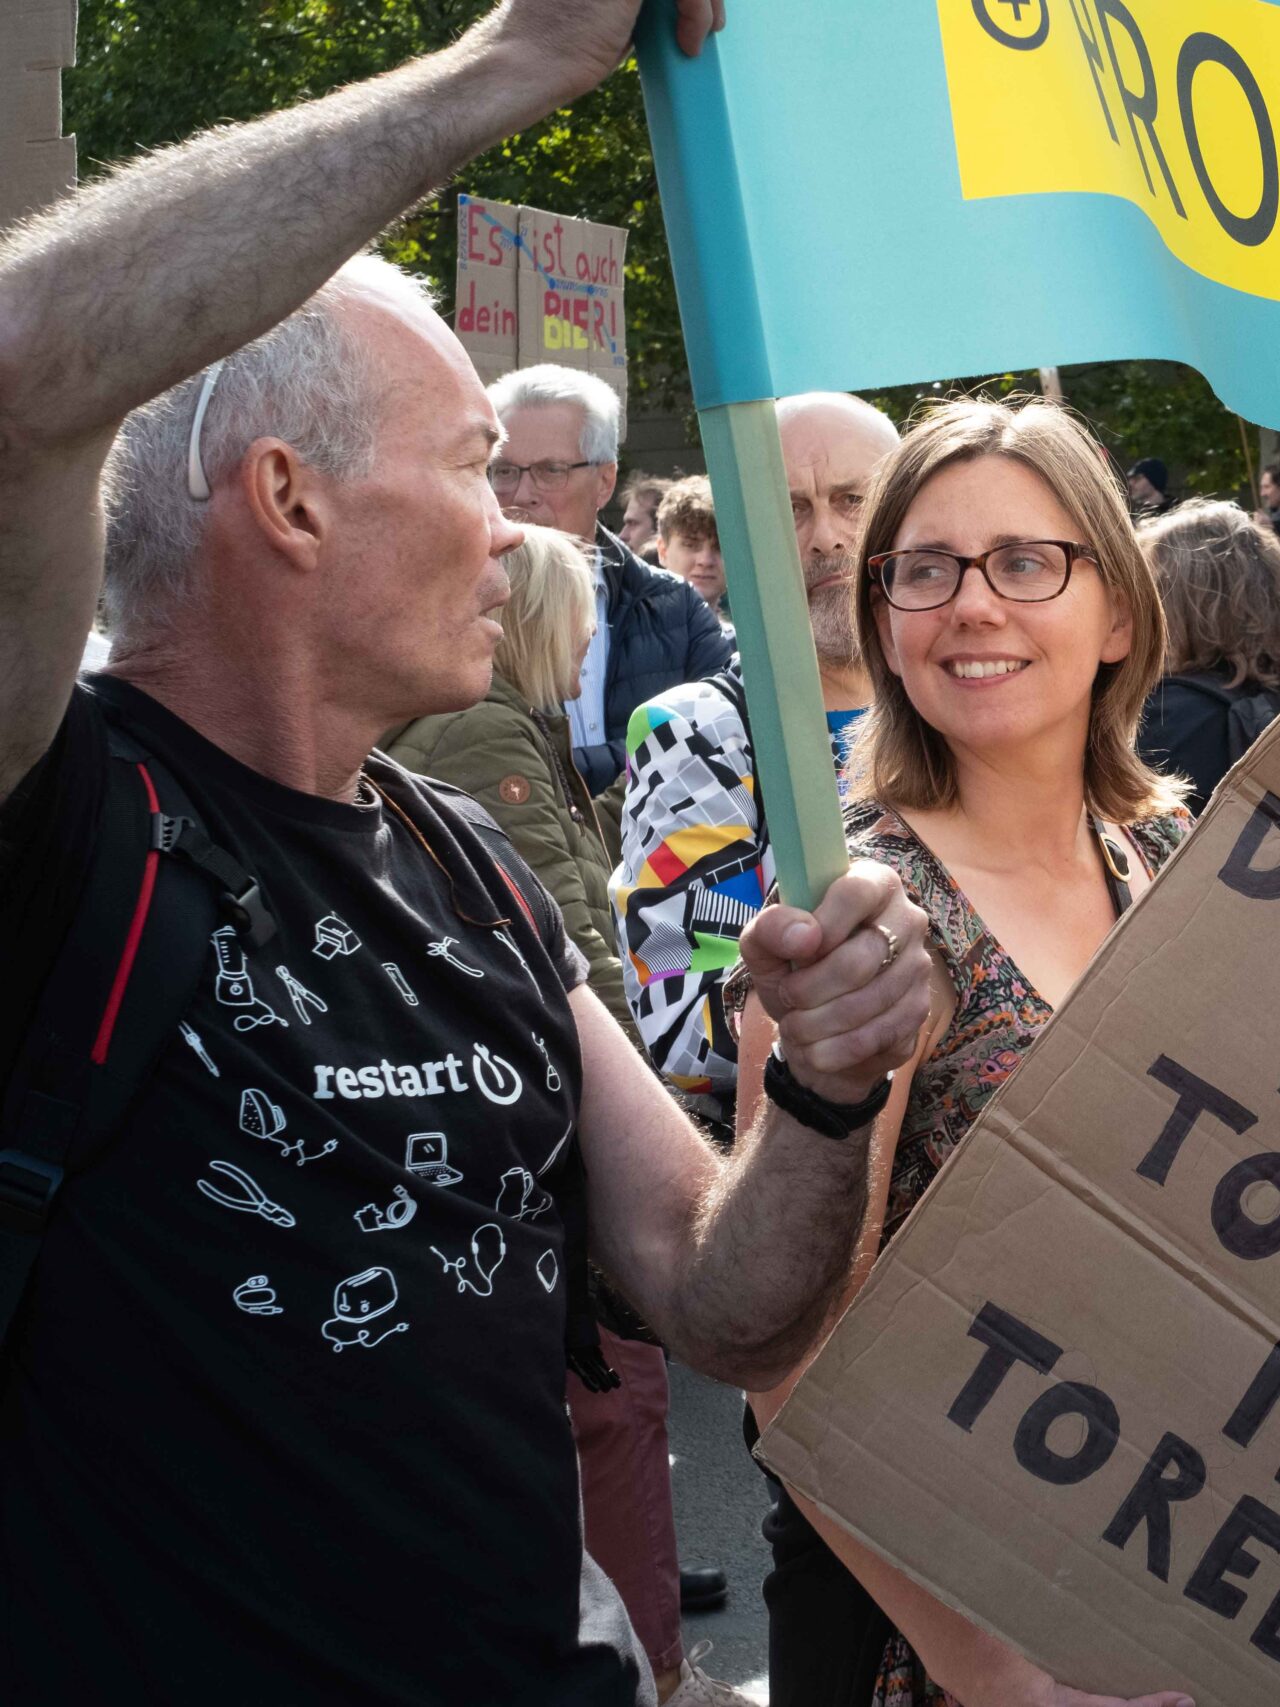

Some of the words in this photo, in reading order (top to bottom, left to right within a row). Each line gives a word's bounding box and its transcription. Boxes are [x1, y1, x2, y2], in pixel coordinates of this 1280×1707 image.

[468, 205, 504, 266] Es
[533, 219, 567, 276] ist
[576, 238, 618, 285] auch
[458, 281, 516, 336] dein
[543, 290, 618, 353] BIER!
[313, 1053, 469, 1100] restart
[946, 1300, 1121, 1486] TO
